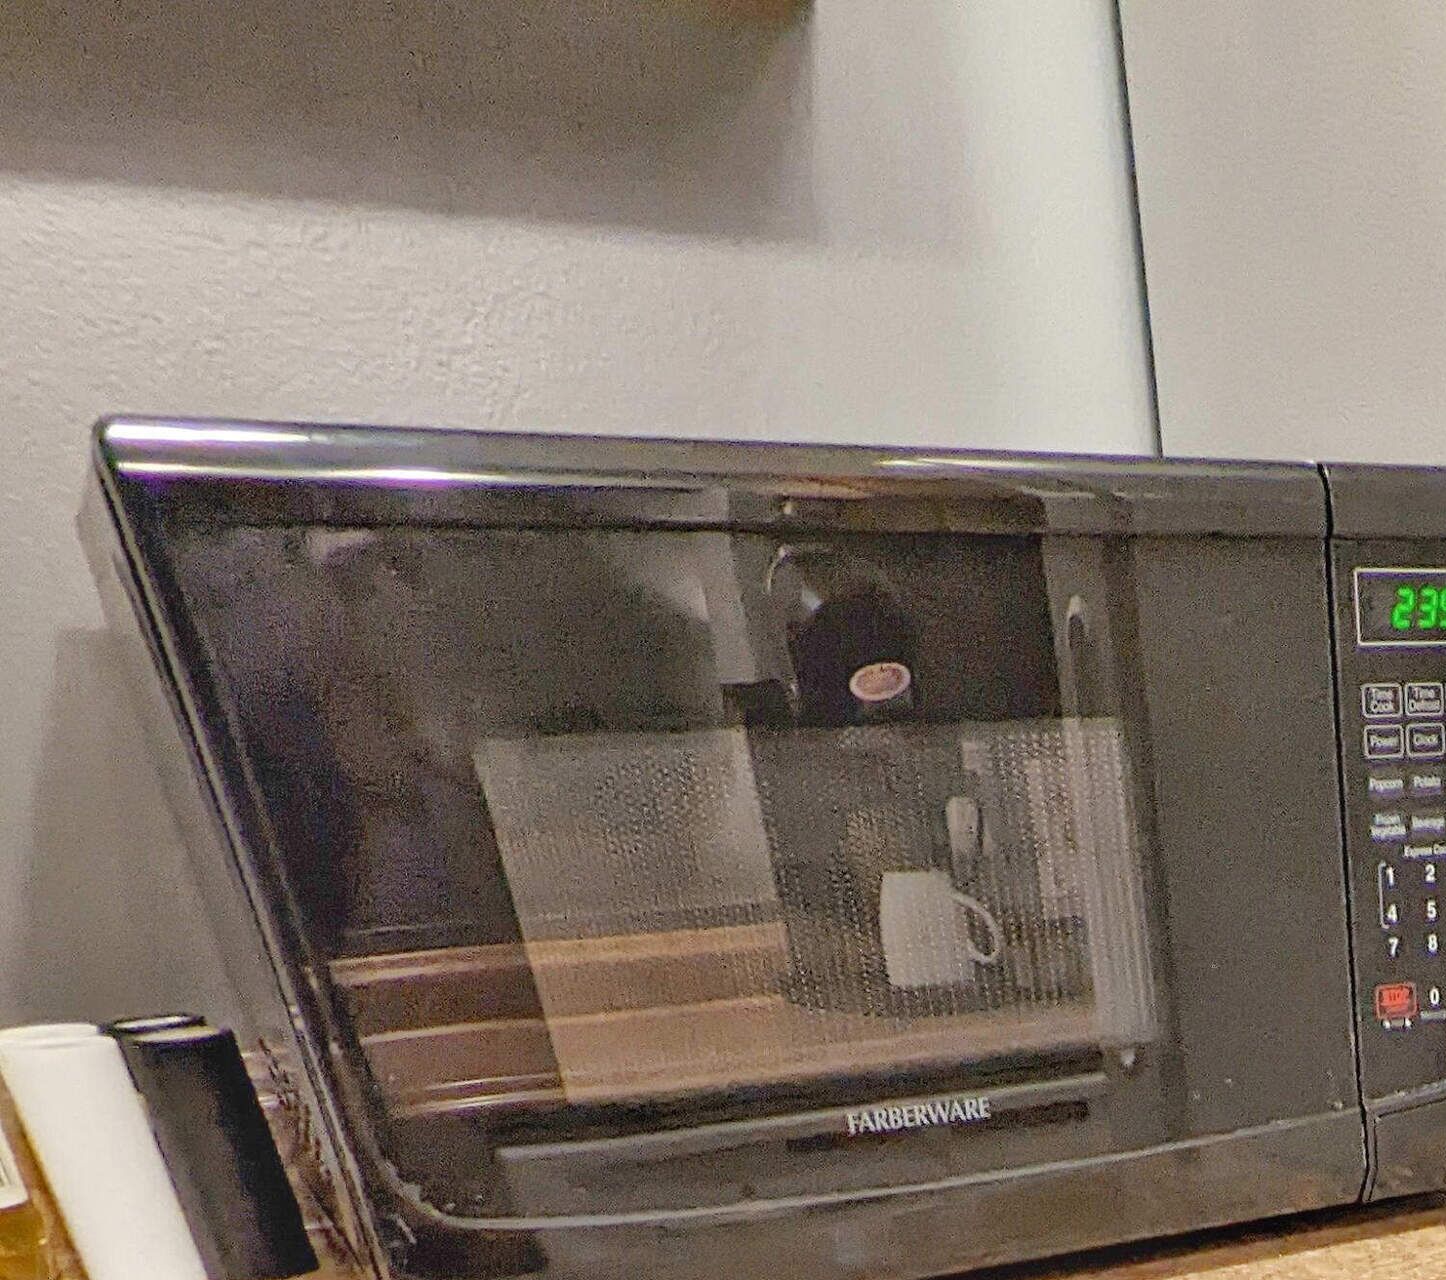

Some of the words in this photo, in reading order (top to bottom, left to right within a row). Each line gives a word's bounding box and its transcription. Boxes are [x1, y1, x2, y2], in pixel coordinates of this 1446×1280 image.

[1386, 866, 1395, 886] 1
[1425, 864, 1435, 882] 2
[1387, 903, 1398, 923] 4
[1427, 900, 1437, 918] 5
[1388, 937, 1399, 957] 7
[1428, 934, 1438, 953] 8
[1429, 987, 1440, 1005] 0
[847, 1097, 992, 1135] FARBERWARE
